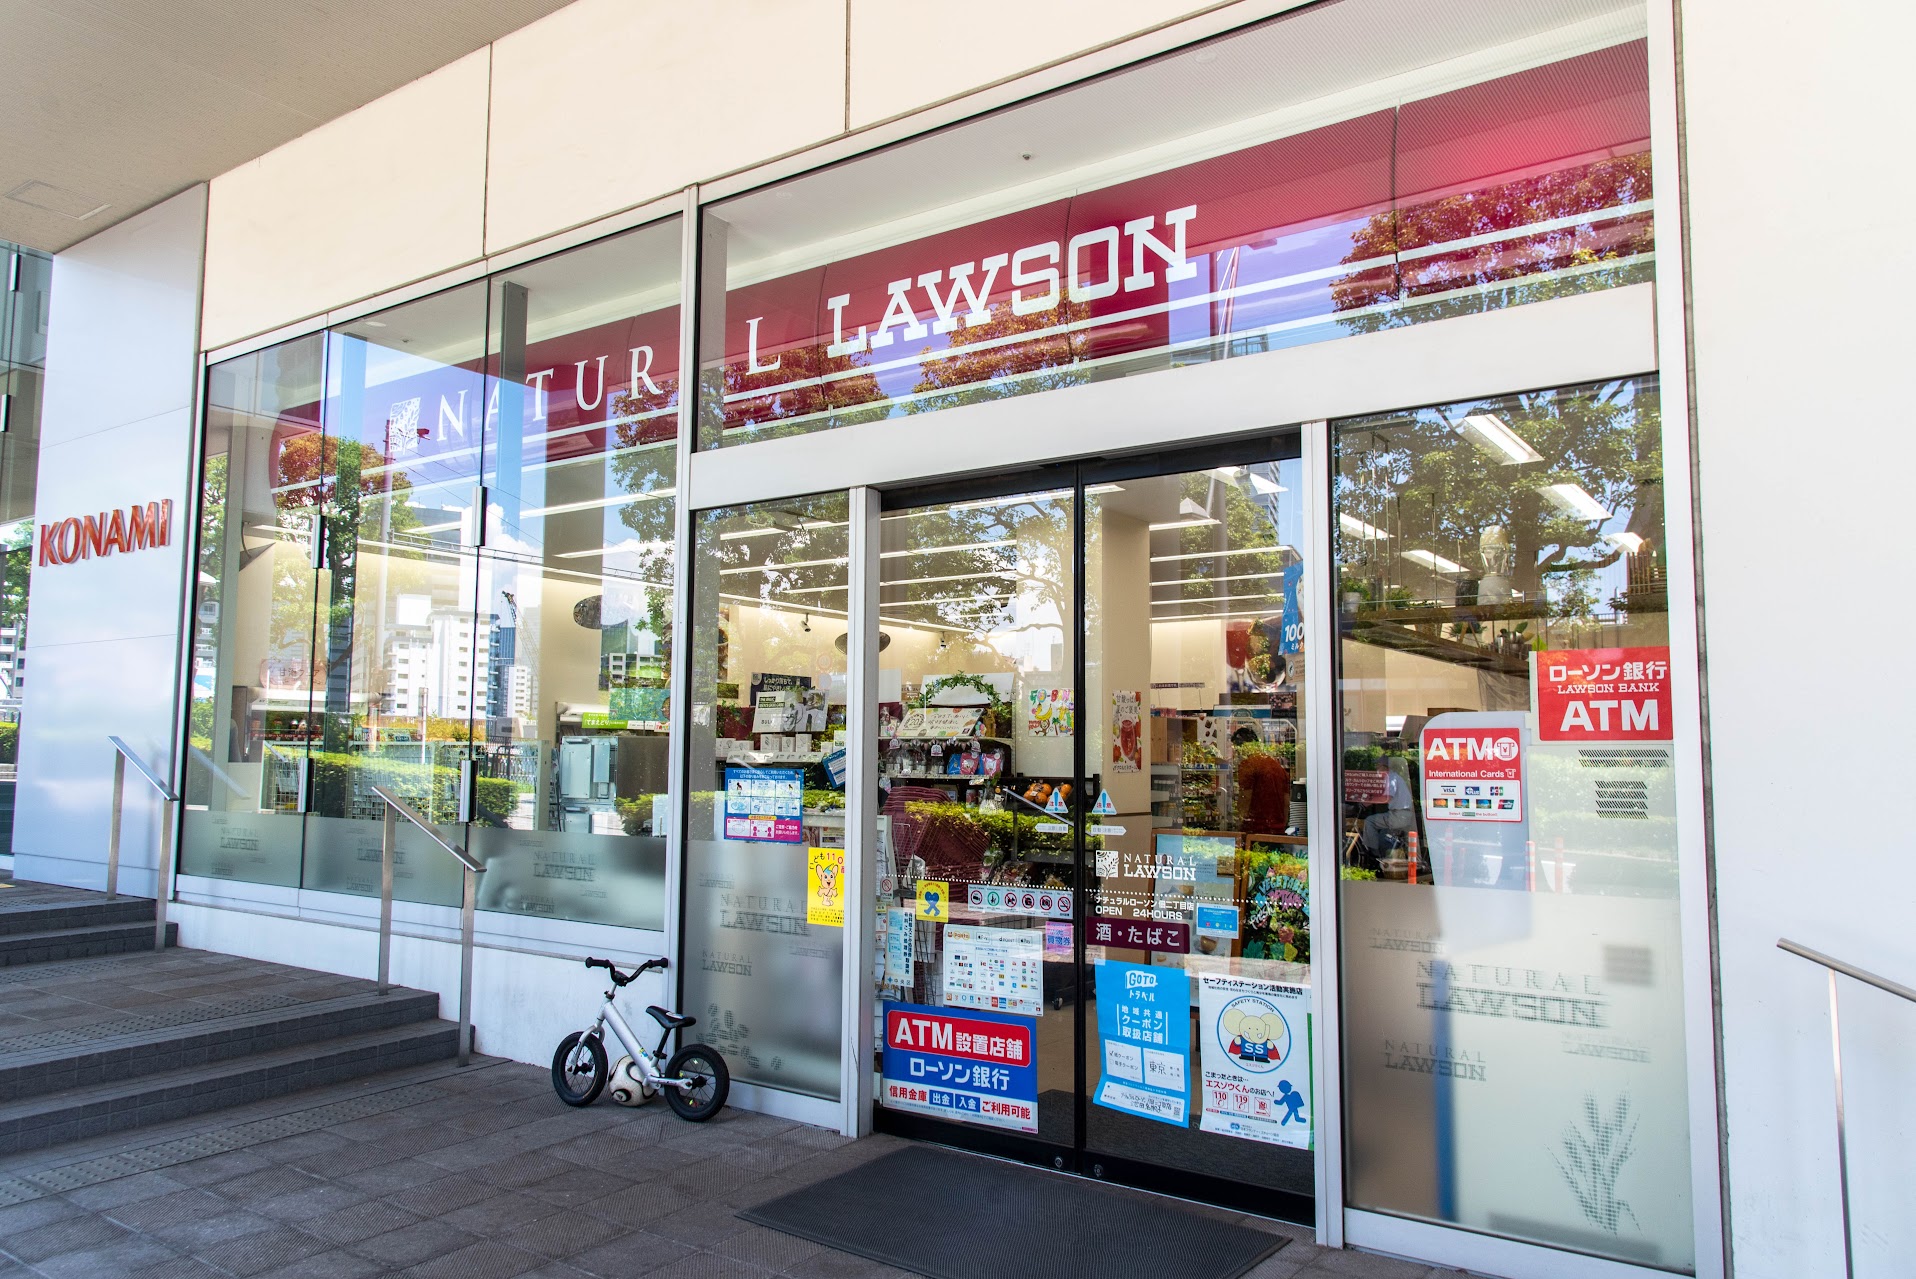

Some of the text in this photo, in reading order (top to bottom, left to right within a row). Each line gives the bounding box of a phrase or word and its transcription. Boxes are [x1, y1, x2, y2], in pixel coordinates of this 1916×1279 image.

[827, 204, 1197, 359] LAWSON
[39, 498, 172, 567] KONAMI
[1549, 661, 1667, 682] ローソン銀行
[1558, 683, 1659, 694] LAWSON BANK
[1560, 699, 1659, 732] ATM
[1426, 737, 1494, 761] ATM
[1429, 769, 1504, 778] International Cards
[1124, 853, 1198, 867] NATURAL
[1123, 864, 1196, 881] LAWSON
[1095, 905, 1183, 921] OPEN 24HOURS
[1096, 922, 1180, 947] 酒・たばこ
[1203, 977, 1303, 995] セーフティステーション活動実施店
[1129, 989, 1155, 1002] トラベル
[1231, 998, 1275, 1013] SAFETY STATION
[1121, 1014, 1163, 1030] クーポン
[1122, 1025, 1164, 1044] 取扱店舗
[909, 1057, 1010, 1091] ローソン銀行
[1149, 1061, 1167, 1075] 東京
[1384, 1052, 1487, 1082] LAWSON
[889, 1085, 927, 1102] 信用金庫
[932, 1092, 951, 1106] 出金
[958, 1096, 977, 1110] 入金
[982, 1100, 1031, 1120] ご利用可能
[1214, 1091, 1248, 1104] 110 119
